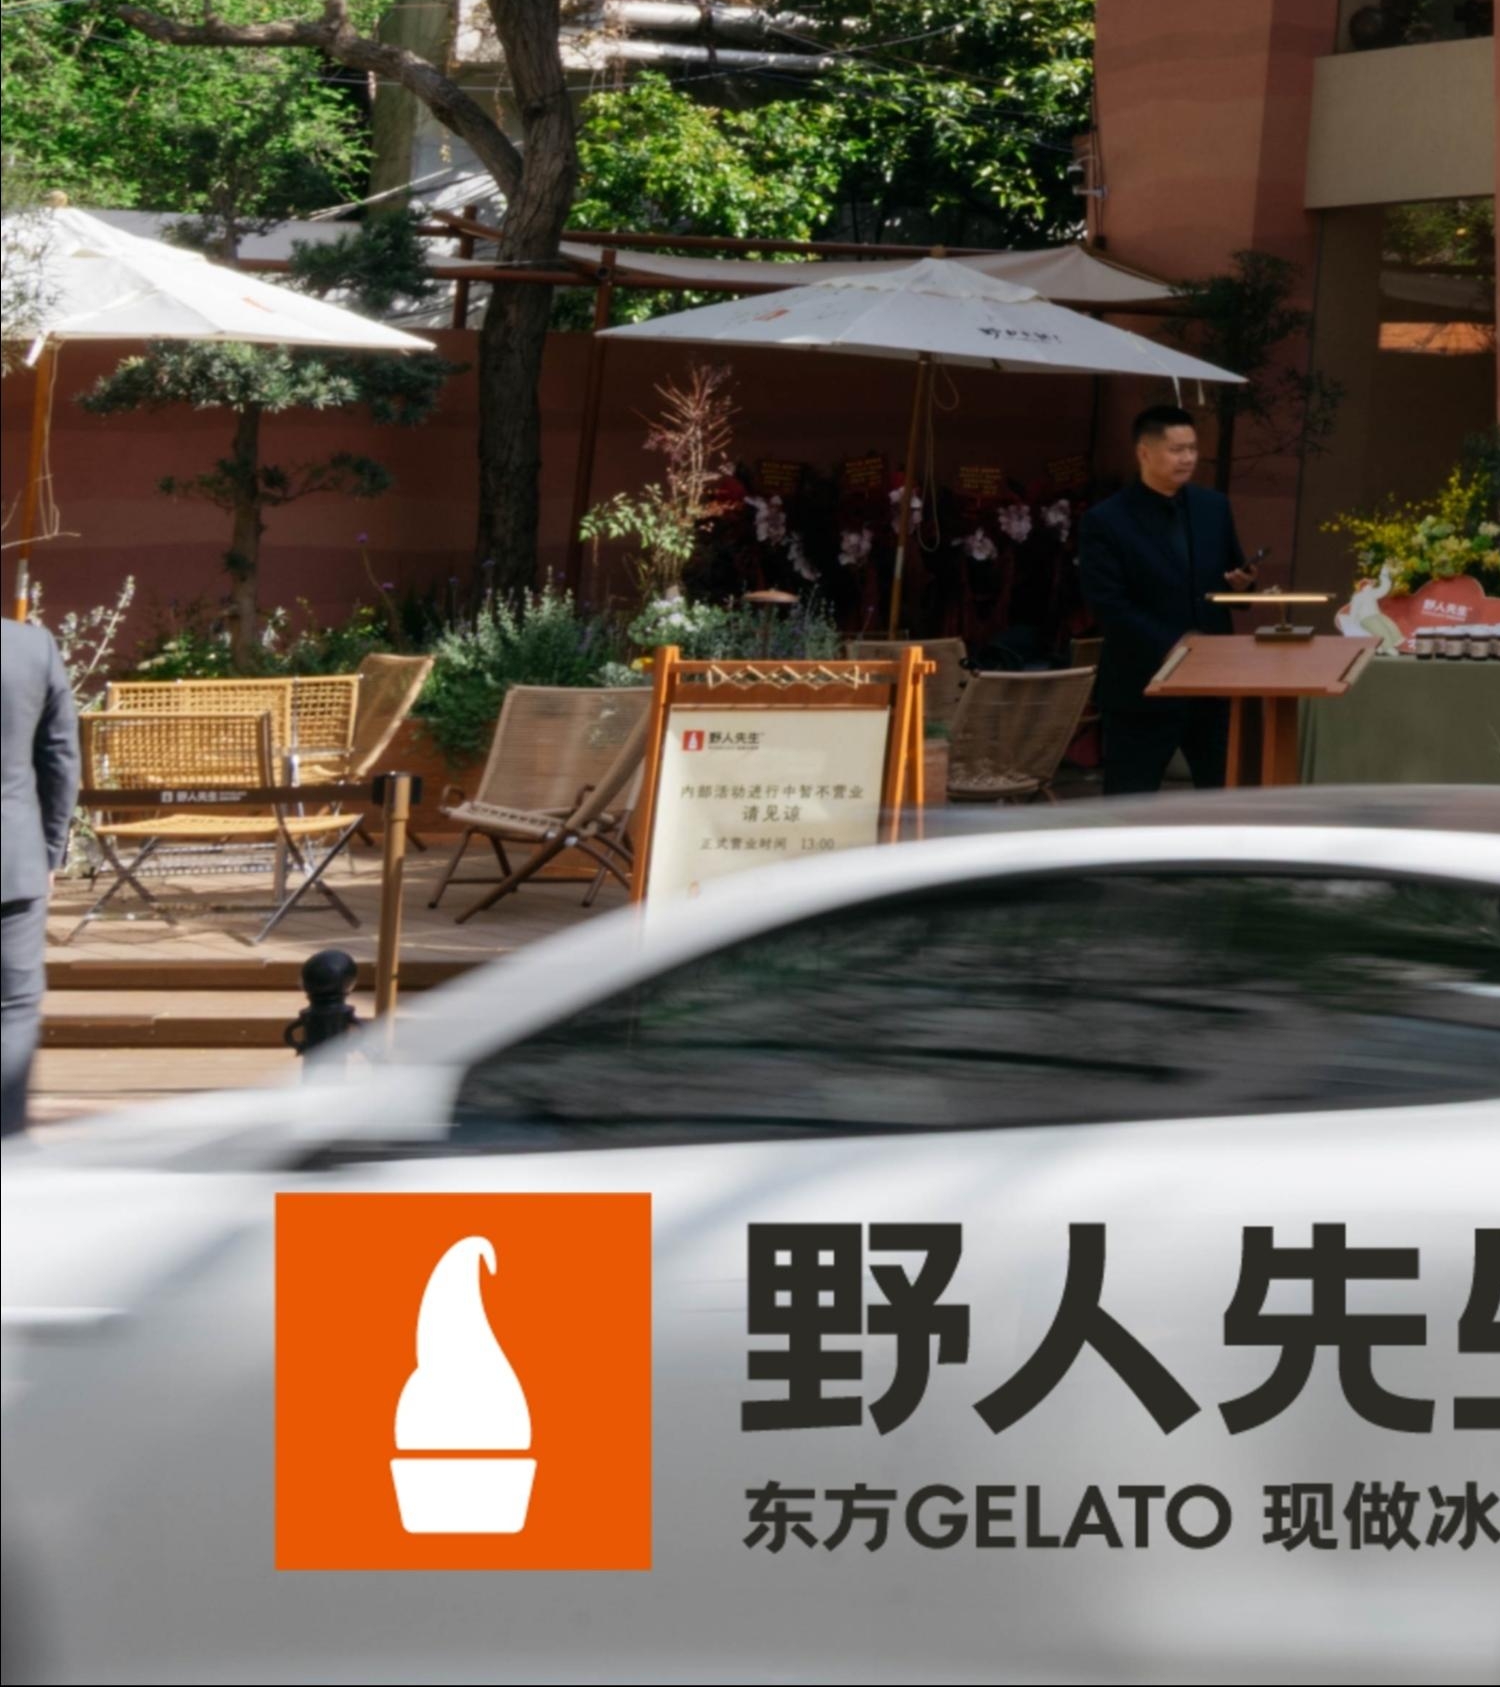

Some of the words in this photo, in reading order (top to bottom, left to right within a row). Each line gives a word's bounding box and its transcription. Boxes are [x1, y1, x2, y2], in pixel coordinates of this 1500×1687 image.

[707, 730, 761, 745] 野人先生
[680, 783, 865, 800] 内部活动进行中暂不营业
[741, 804, 804, 823] 请见谅
[699, 836, 788, 851] 正式营业时间
[800, 837, 836, 851] 13:00
